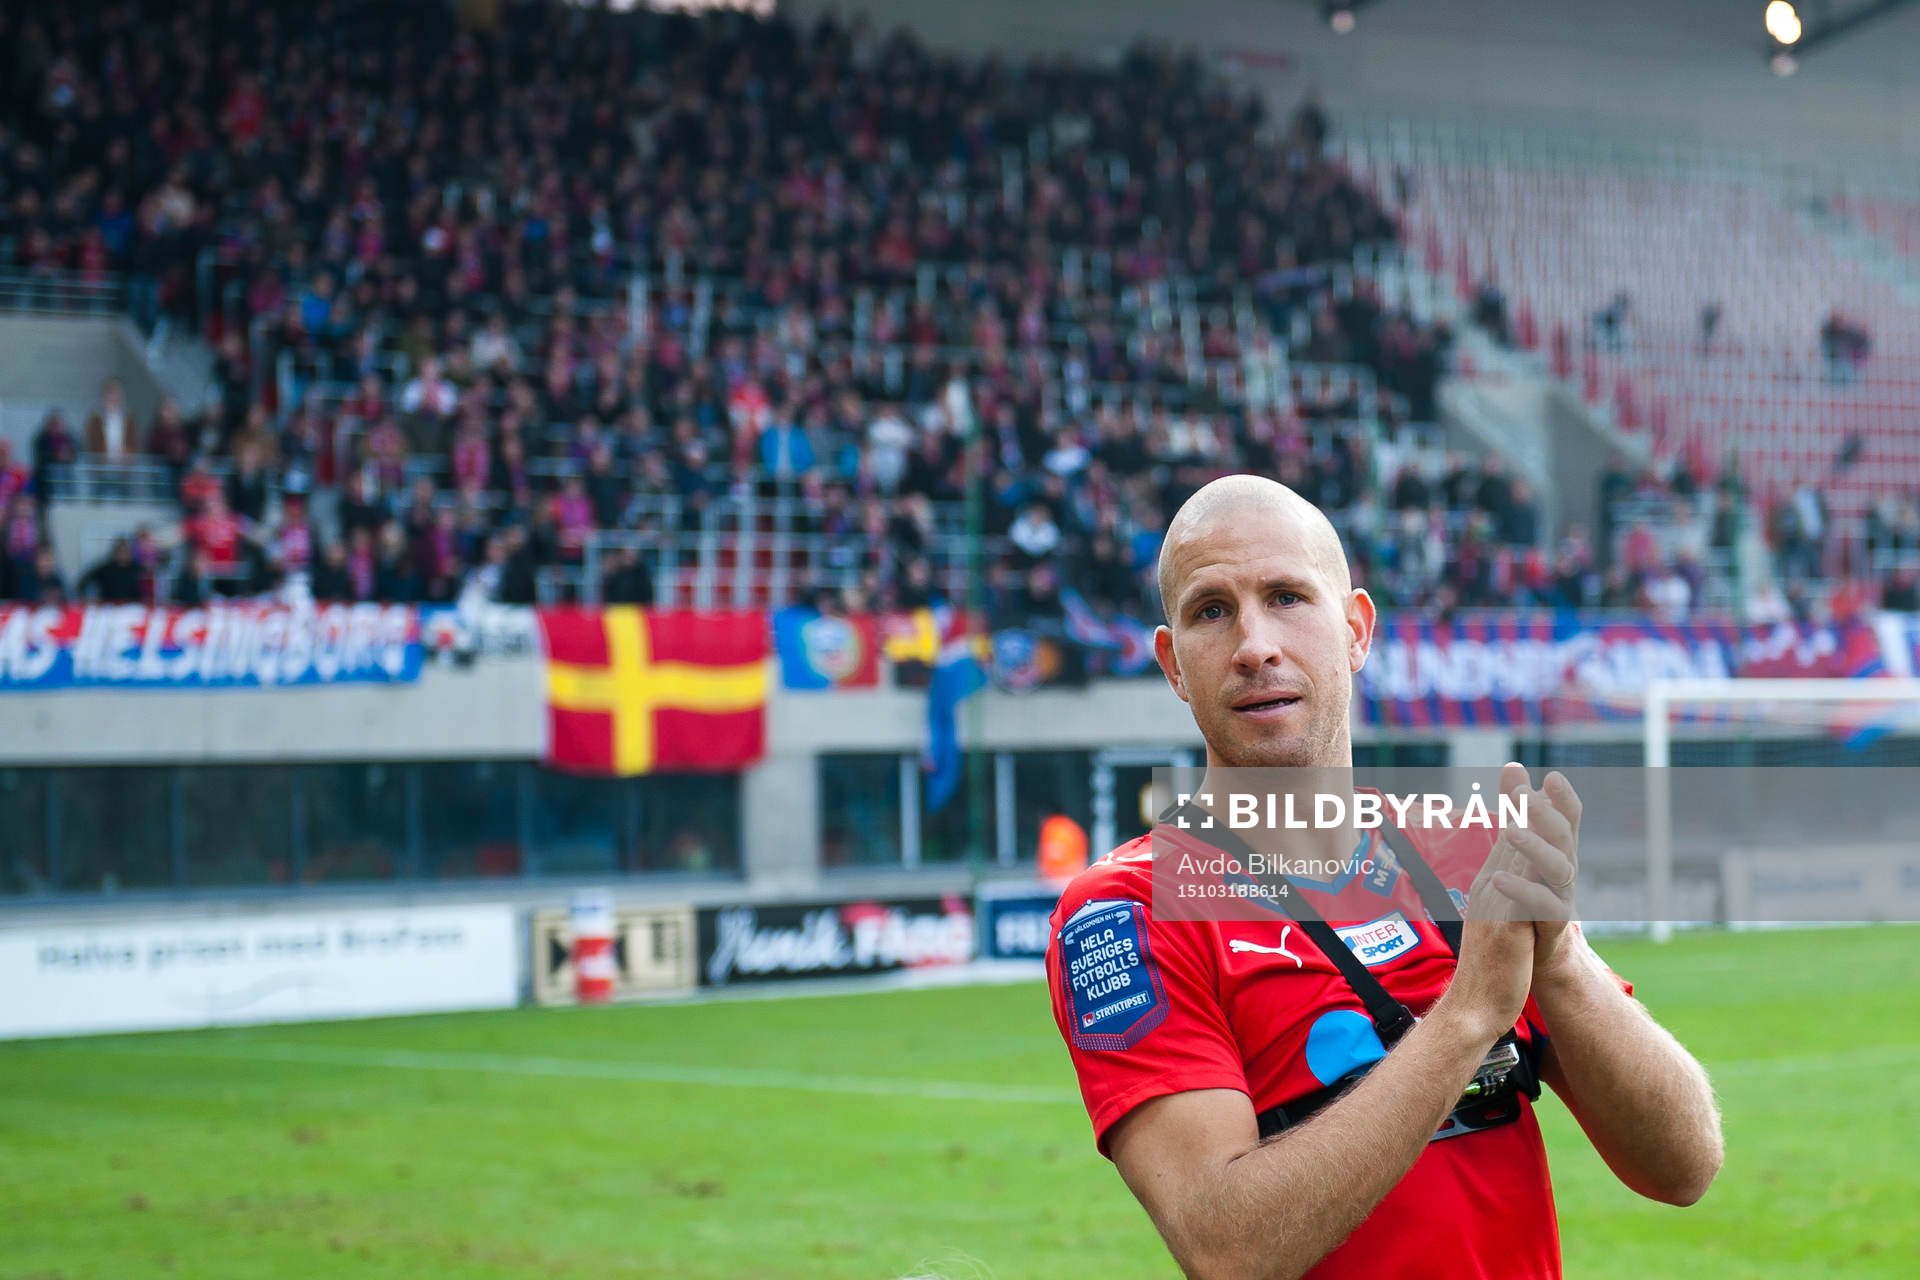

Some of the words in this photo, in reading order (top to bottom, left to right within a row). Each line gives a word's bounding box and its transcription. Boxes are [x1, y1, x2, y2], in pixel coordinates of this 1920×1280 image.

[1080, 928, 1115, 952] HELA
[1352, 923, 1399, 946] INTER
[1362, 934, 1405, 958] SPORT
[1070, 937, 1134, 974] SVERIGES
[1072, 952, 1140, 991] FOTBOLLS
[1086, 972, 1132, 1001] KLUBB
[1095, 993, 1148, 1020] STRYKTIPSET
